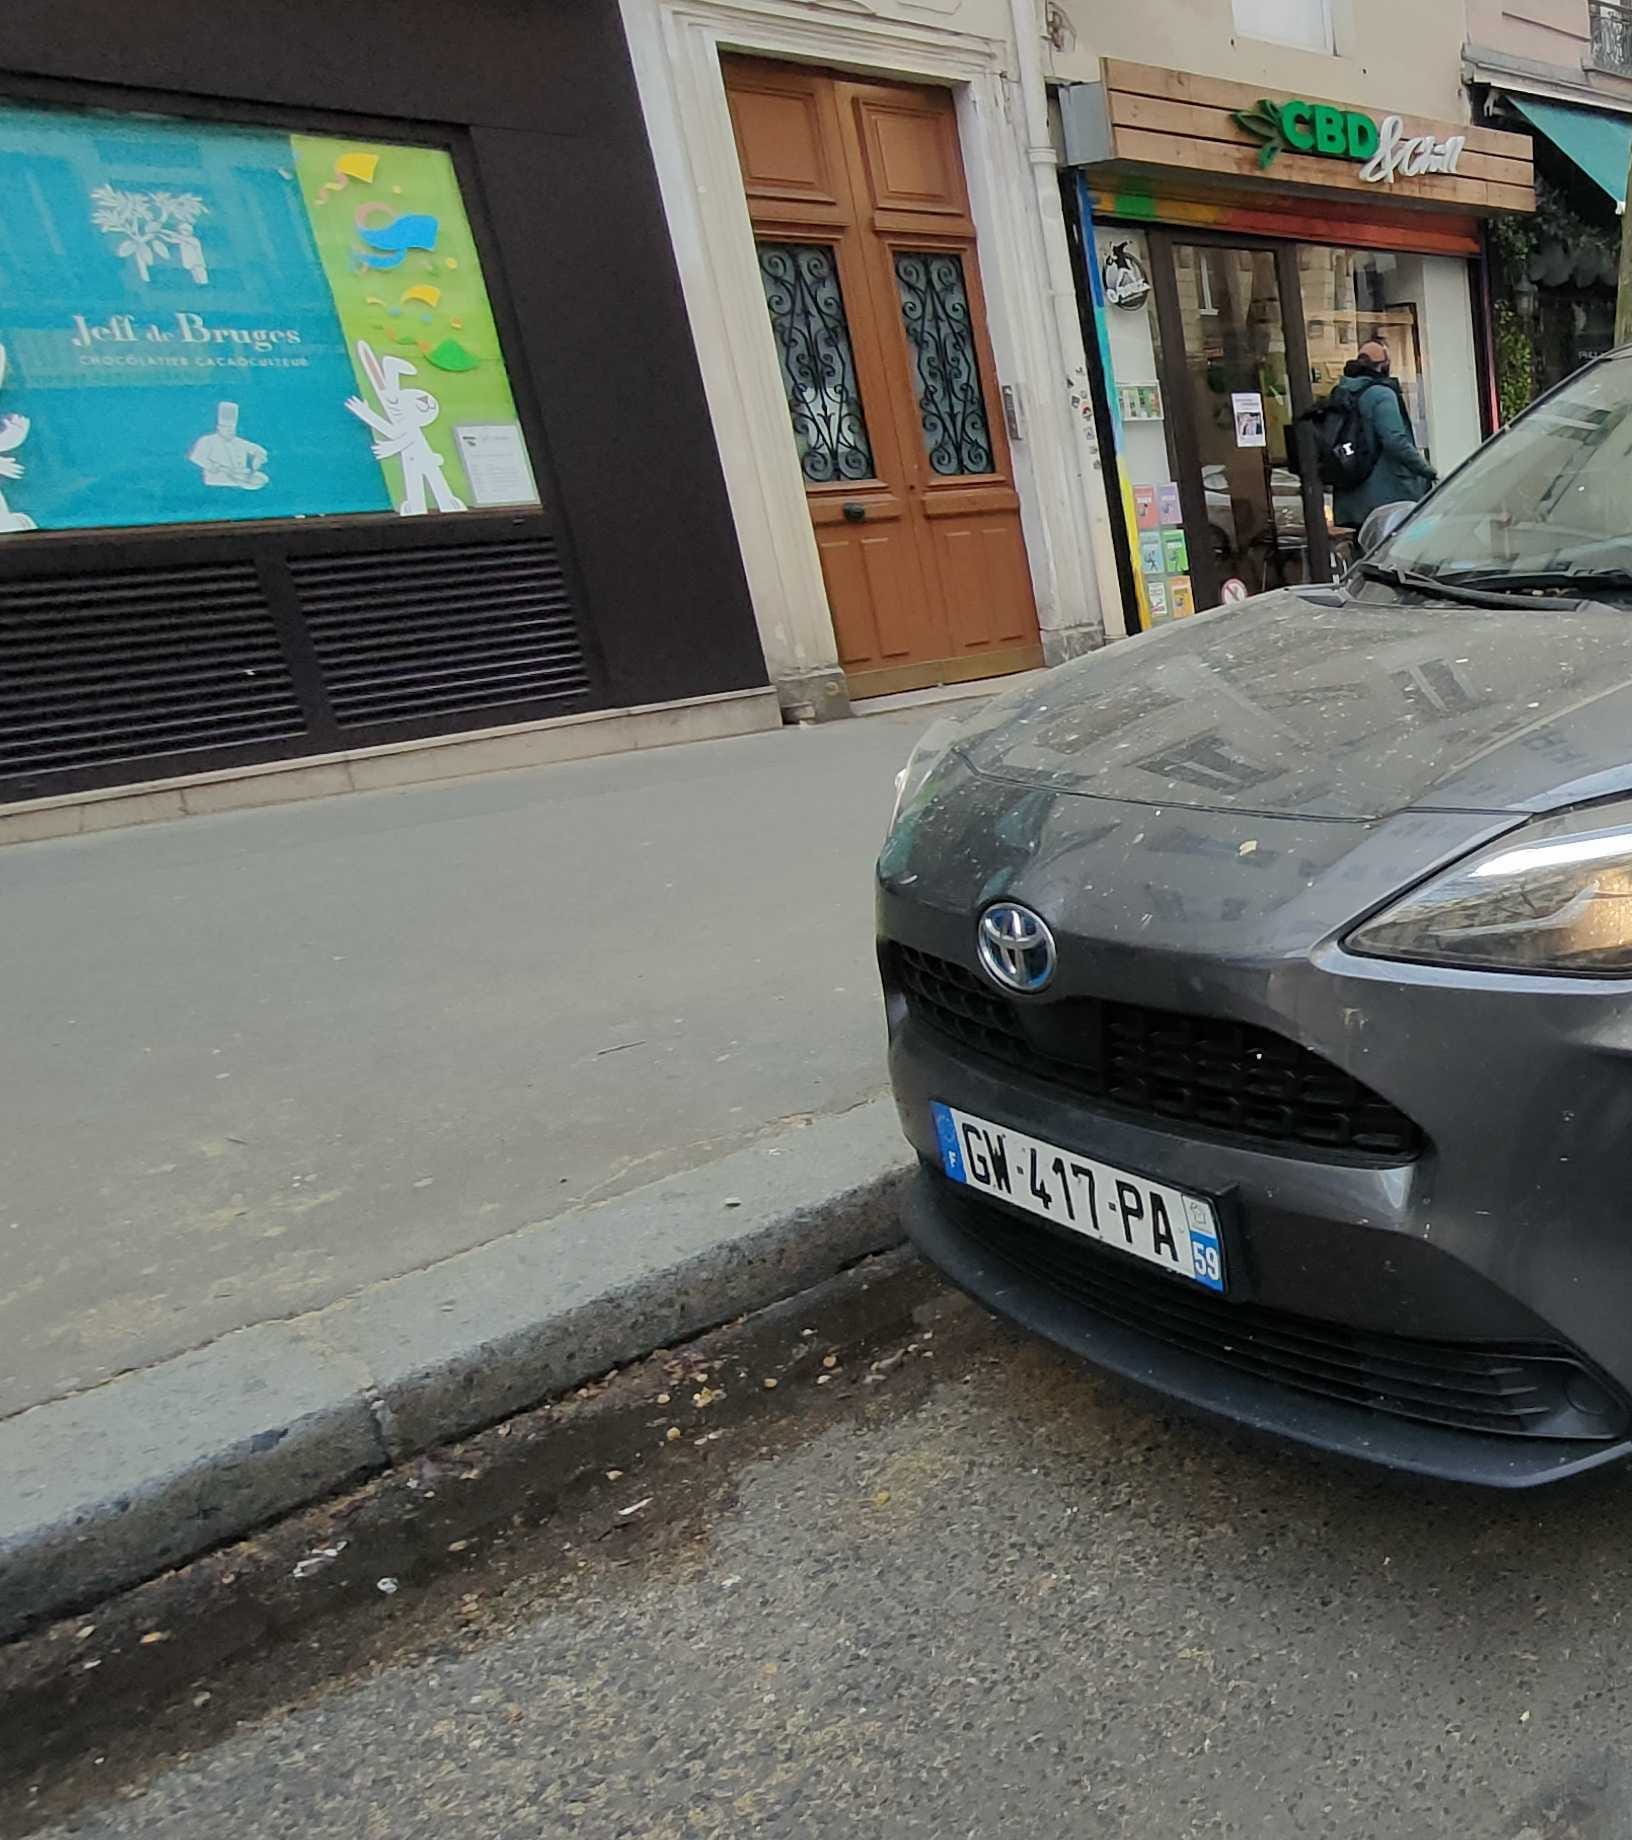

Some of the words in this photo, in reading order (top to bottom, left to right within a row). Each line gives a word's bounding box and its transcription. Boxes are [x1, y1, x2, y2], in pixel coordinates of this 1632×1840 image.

[1281, 99, 1380, 159] CBD
[71, 313, 139, 346] Jeff
[147, 324, 175, 343] de
[175, 311, 301, 352] Bruges
[80, 355, 189, 367] CHOCOLATIER
[949, 1151, 957, 1167] F
[1192, 1241, 1220, 1281] 59
